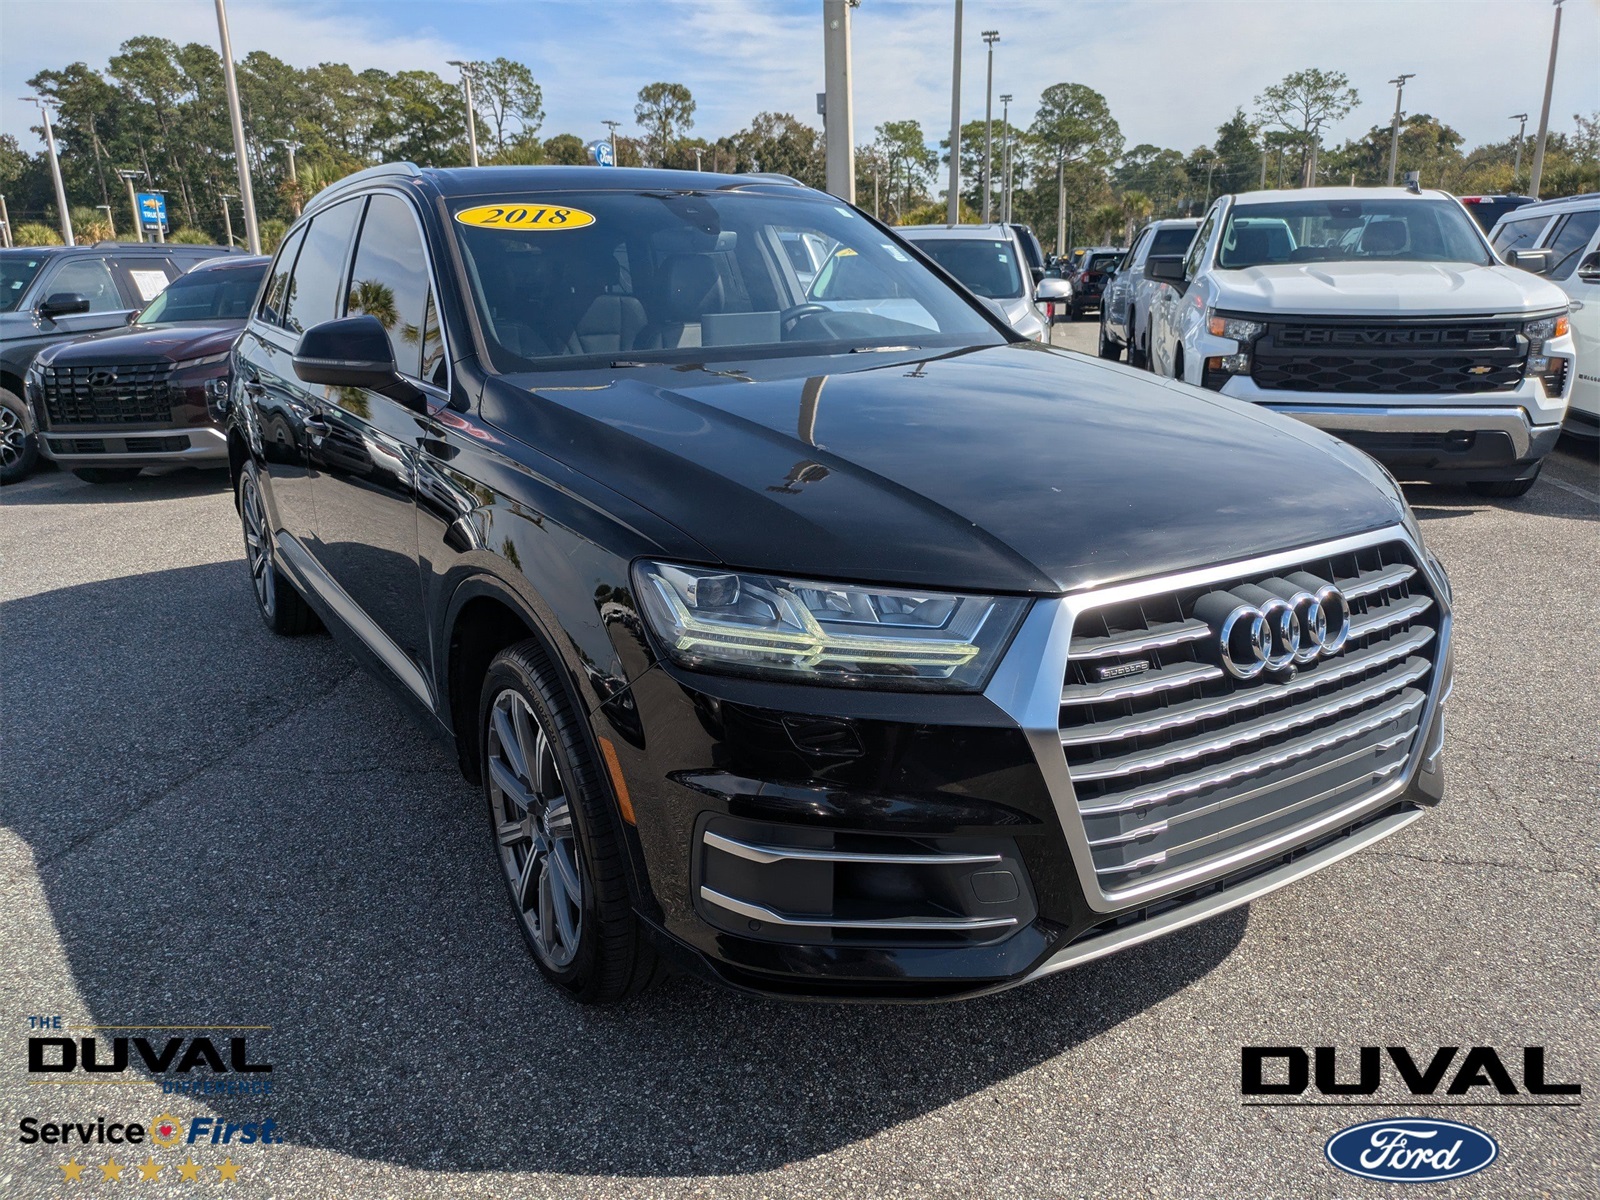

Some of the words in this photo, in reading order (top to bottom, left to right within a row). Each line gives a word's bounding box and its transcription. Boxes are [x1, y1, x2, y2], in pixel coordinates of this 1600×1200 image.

[480, 208, 571, 225] 2018
[1278, 328, 1517, 344] CHEVROLET
[1103, 662, 1149, 677] quattro
